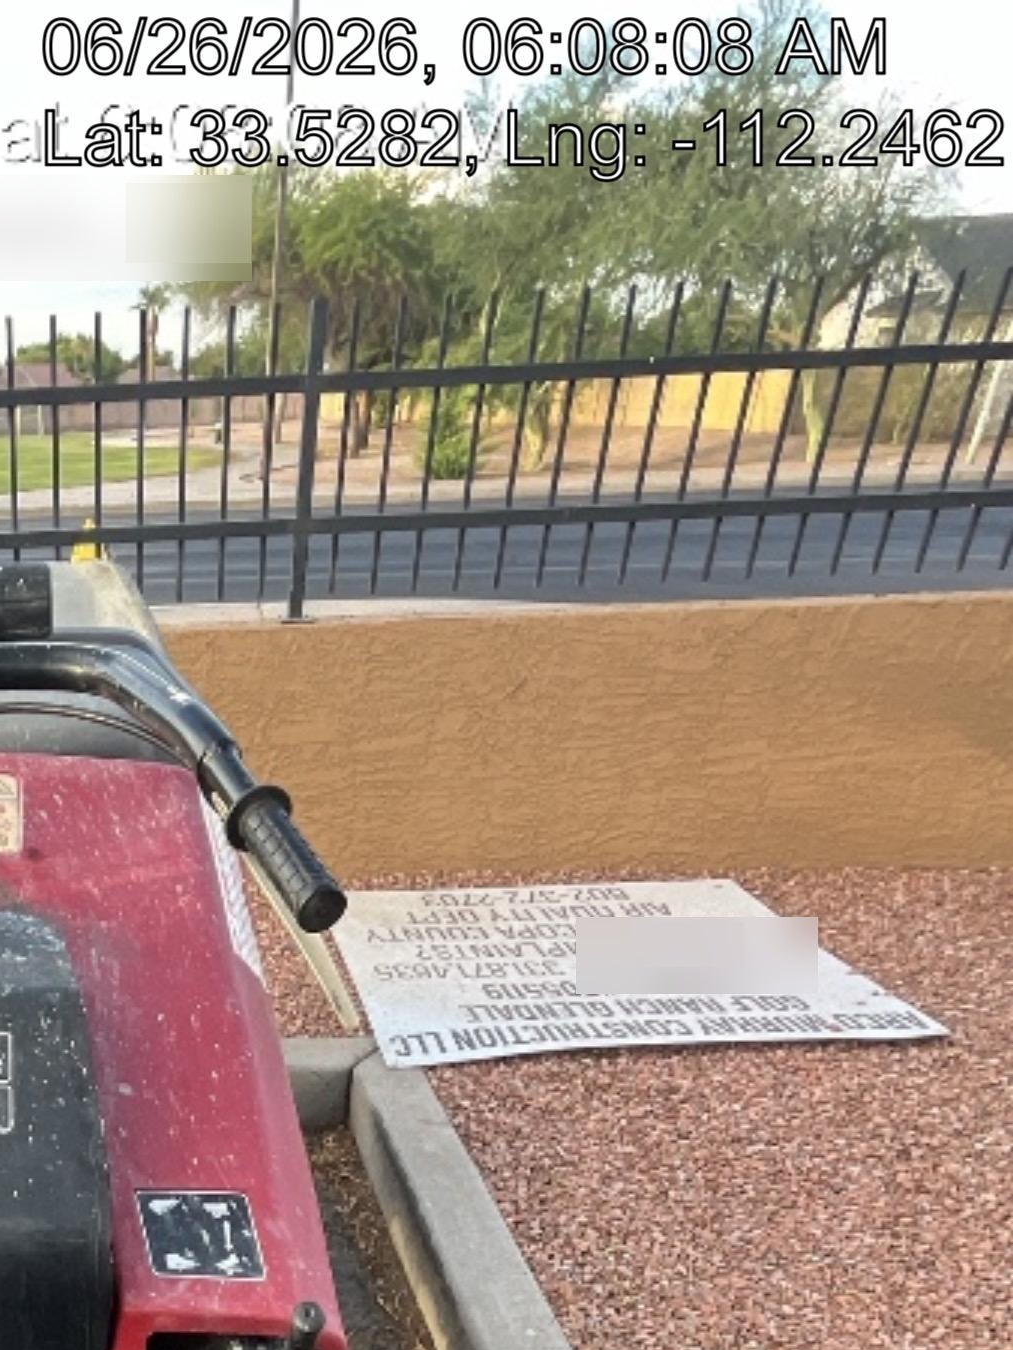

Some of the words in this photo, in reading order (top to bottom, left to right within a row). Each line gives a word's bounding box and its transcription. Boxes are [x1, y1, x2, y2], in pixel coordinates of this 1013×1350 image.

[407, 908, 480, 925] DEPT
[367, 926, 489, 944] COUNTY
[494, 923, 576, 940] COPA
[458, 999, 615, 1023] GLENDALE
[731, 995, 812, 1012] GOLF
[389, 1031, 448, 1057] LLC
[451, 1019, 694, 1051] CONSTRUCTION
